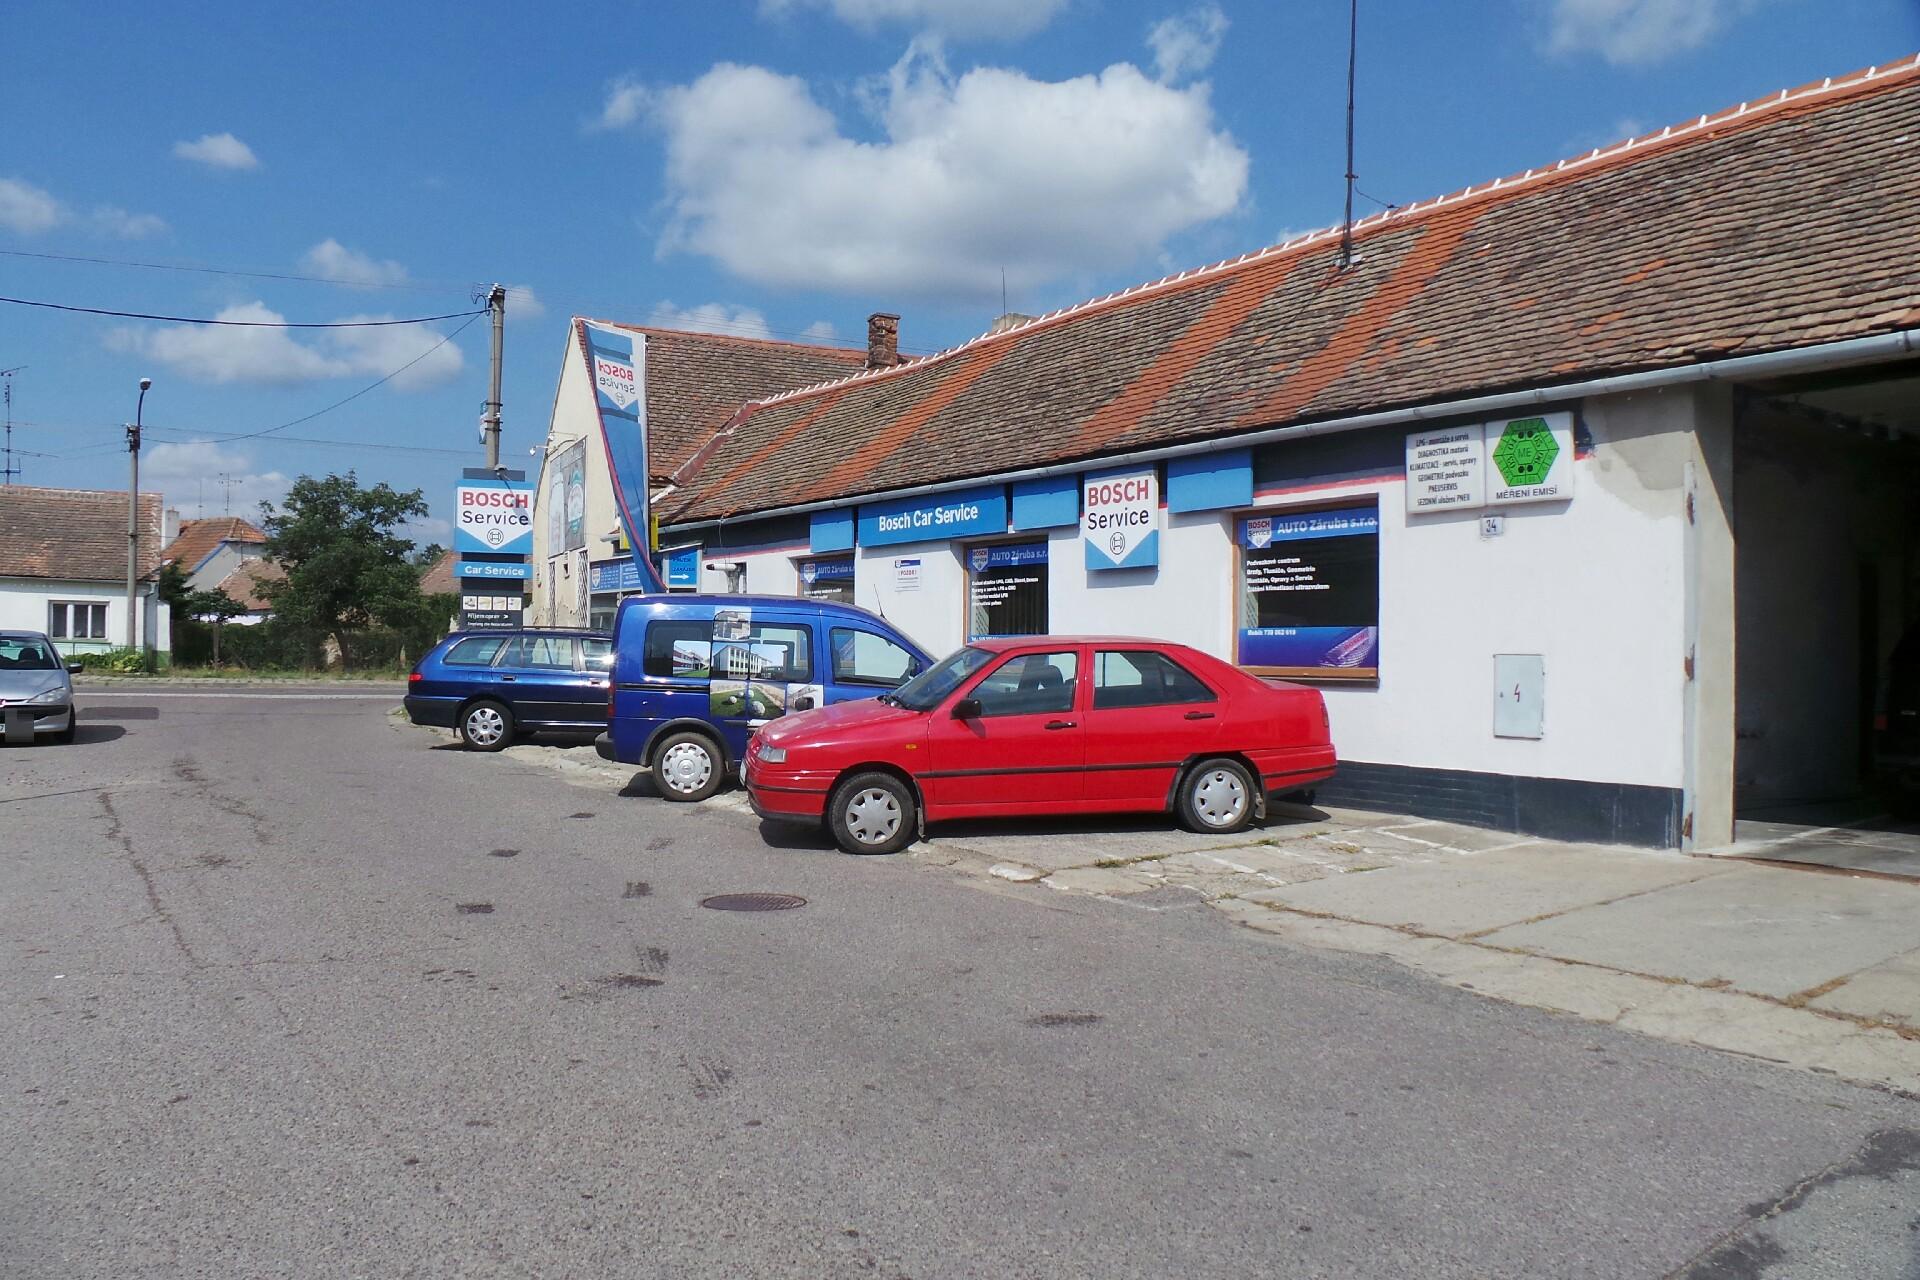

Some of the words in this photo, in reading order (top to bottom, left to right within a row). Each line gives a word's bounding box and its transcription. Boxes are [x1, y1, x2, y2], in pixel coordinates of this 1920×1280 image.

[1455, 432, 1469, 440] servis
[1418, 448, 1448, 458] DIAGNOSTIKA
[1410, 461, 1439, 471] KLIMATIZACE
[1459, 458, 1476, 466] opravy
[1418, 472, 1444, 482] GEOMETRIE
[1088, 479, 1148, 507] BOSCH
[1428, 483, 1458, 493] PNEUSERVIS
[1496, 488, 1530, 499] MĚŘENÍ
[1533, 484, 1557, 496] EMISÍ
[463, 492, 528, 508] BOSCH
[1456, 494, 1470, 502] PNEU
[462, 511, 529, 525] Service
[879, 512, 910, 531] Bosch
[913, 511, 932, 527] Car
[935, 504, 978, 524] Service
[1088, 507, 1149, 530] Service
[1248, 520, 1270, 529] BOSCH
[1278, 521, 1307, 534] AUTO
[1309, 517, 1348, 531] Záruba
[1350, 517, 1377, 527] s.r.o.
[1486, 519, 1496, 533] 34
[992, 552, 1010, 560] AUTO
[1011, 550, 1035, 560] Záruba
[465, 566, 482, 574] Car
[485, 566, 524, 576] Service
[818, 566, 830, 574] AUTO
